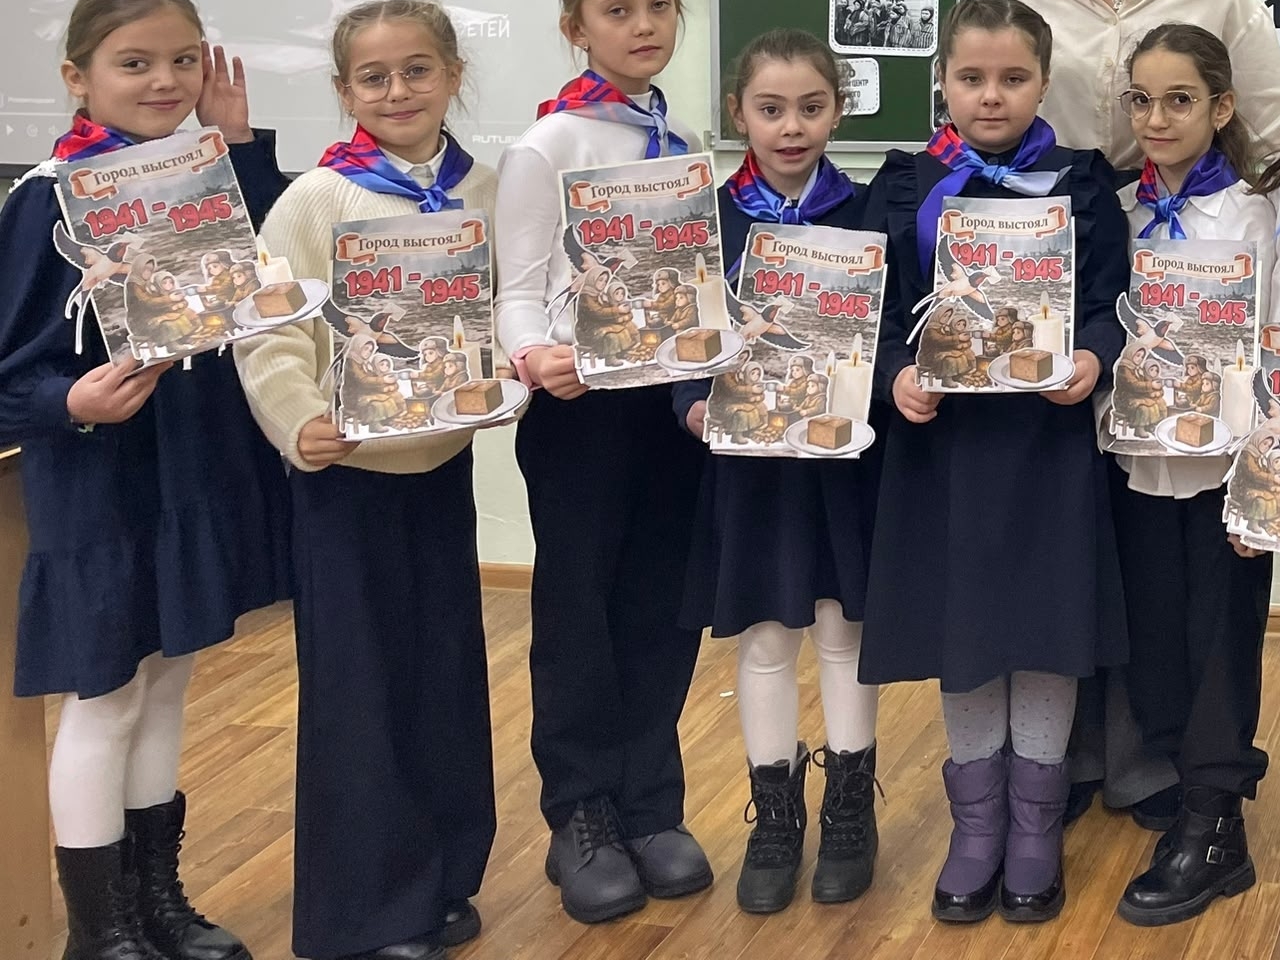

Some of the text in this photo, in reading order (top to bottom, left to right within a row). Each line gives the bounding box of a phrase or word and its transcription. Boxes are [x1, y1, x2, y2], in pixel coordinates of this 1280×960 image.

[94, 148, 204, 187] Город выстоял
[591, 177, 690, 199] Город выстоял
[84, 193, 233, 238] 1941 1945
[577, 214, 709, 252] 1941 1945
[960, 216, 1048, 230] Город выстоял
[358, 231, 462, 252] Город выстоял
[772, 241, 864, 265] Город выстоял
[951, 243, 1064, 282] 1941 1945
[1152, 257, 1235, 274] Город выстоял
[344, 267, 479, 305] 1941 1945
[753, 269, 870, 319] 1941 1945
[1139, 283, 1247, 325] 1941 1945
